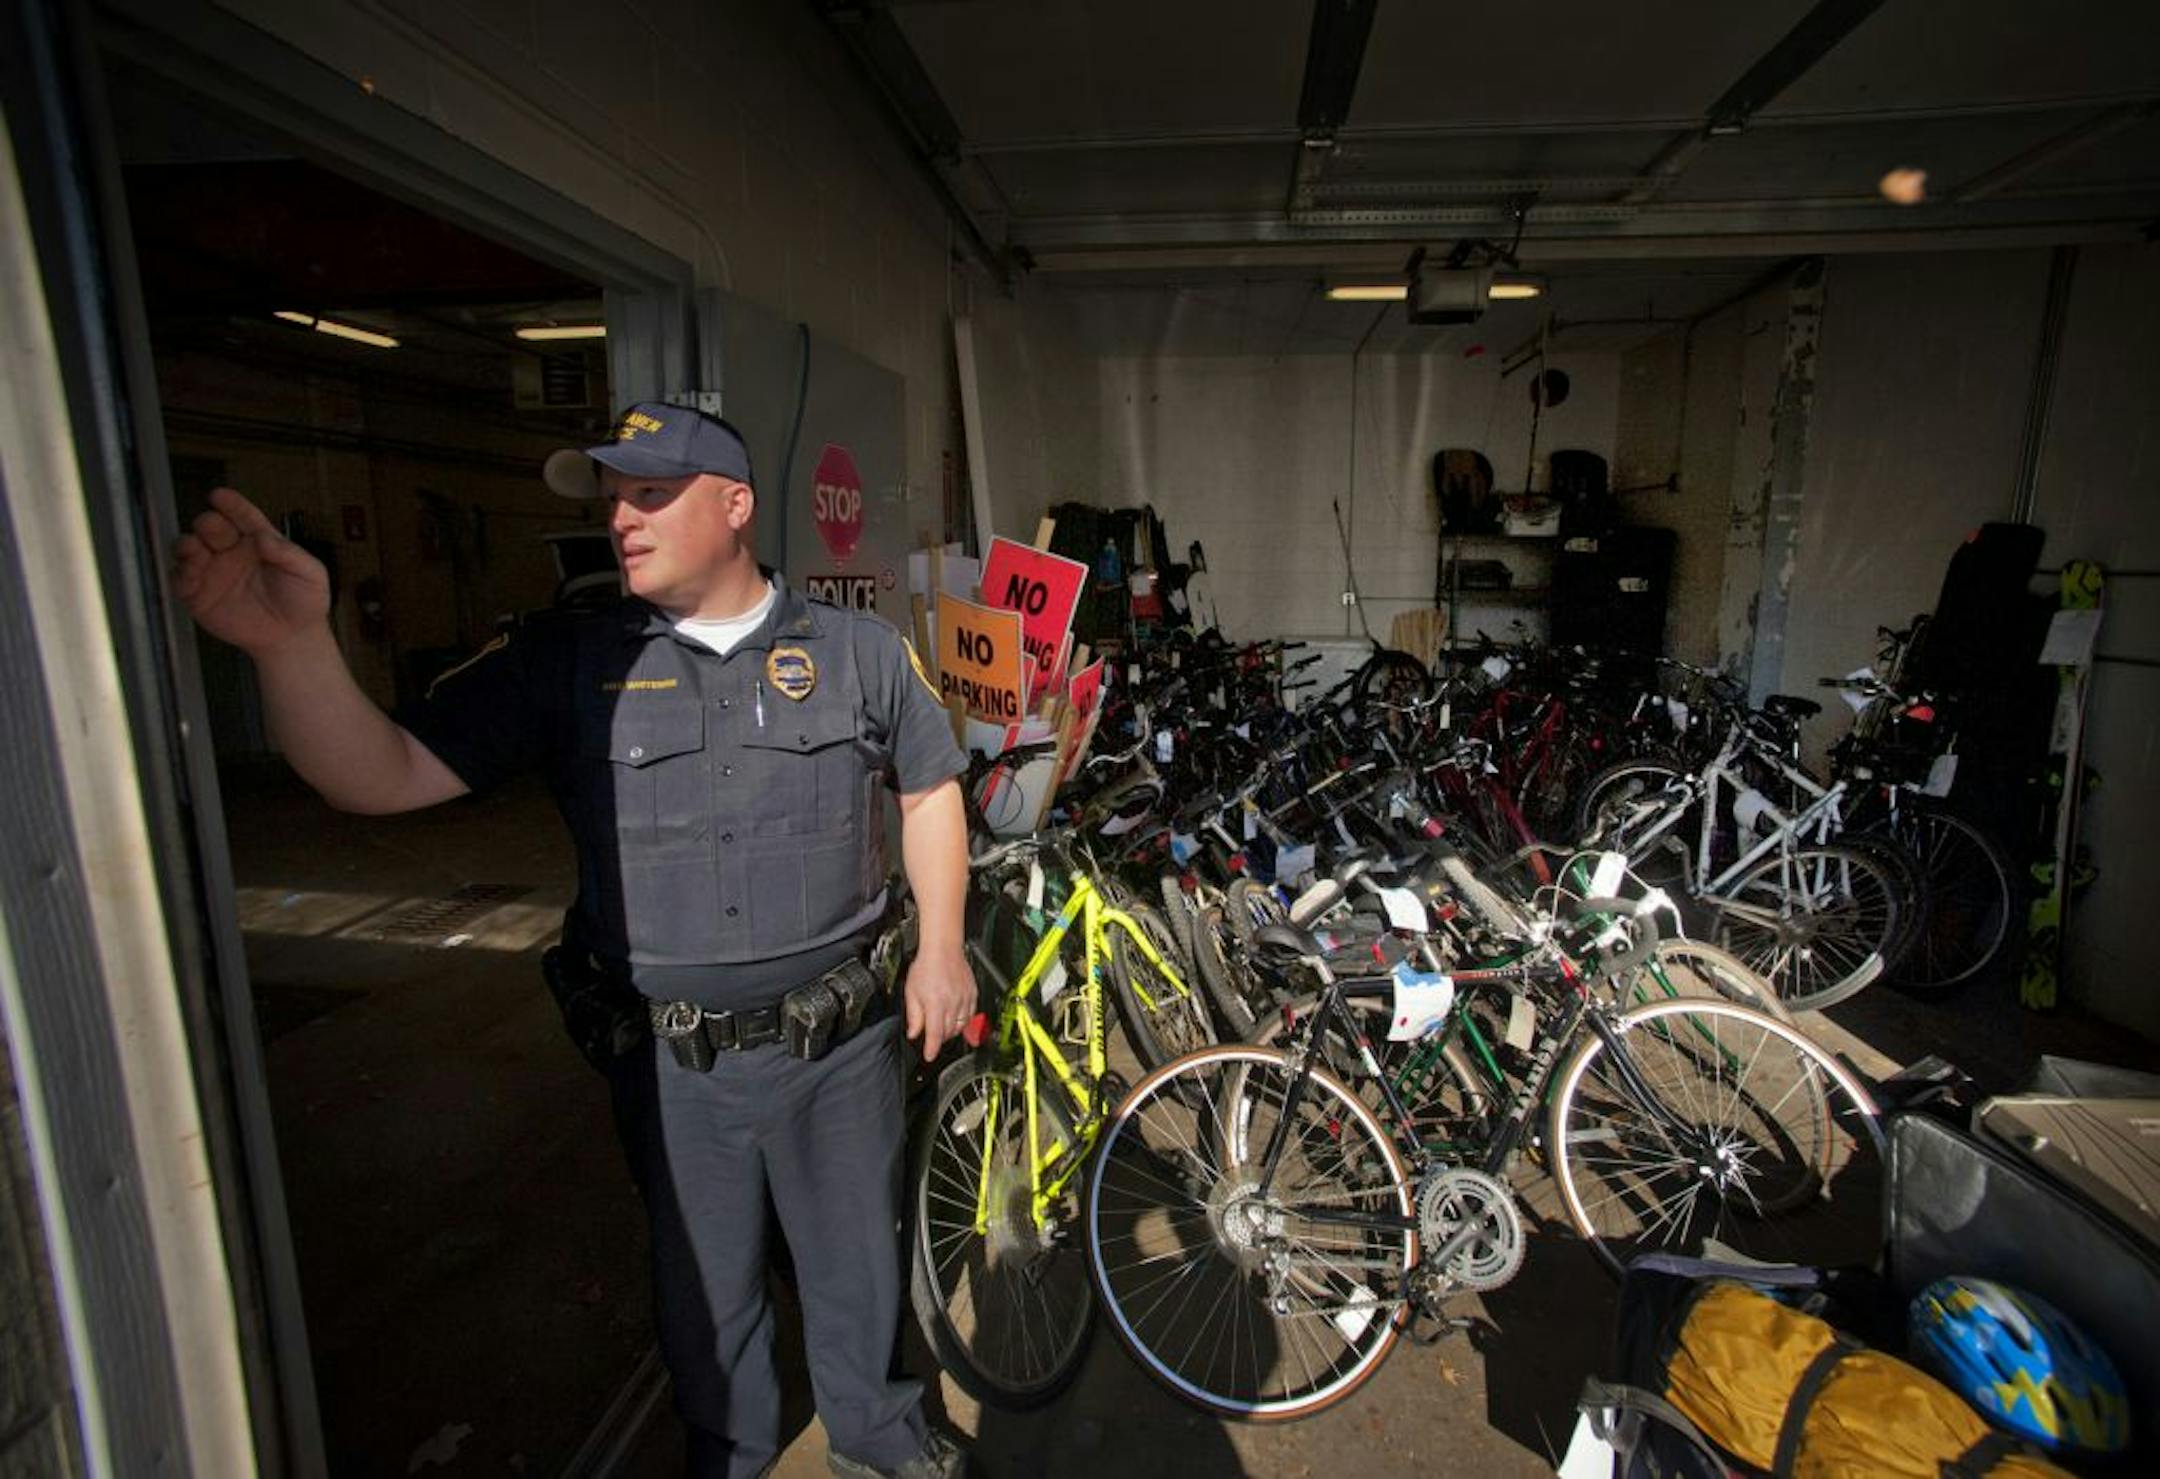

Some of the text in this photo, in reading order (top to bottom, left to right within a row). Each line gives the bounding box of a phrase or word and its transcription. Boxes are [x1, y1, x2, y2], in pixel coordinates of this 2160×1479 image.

[815, 484, 861, 523] STOP
[1004, 573, 1048, 616] NO
[957, 626, 994, 667] NO
[940, 669, 1017, 718] PARKING
